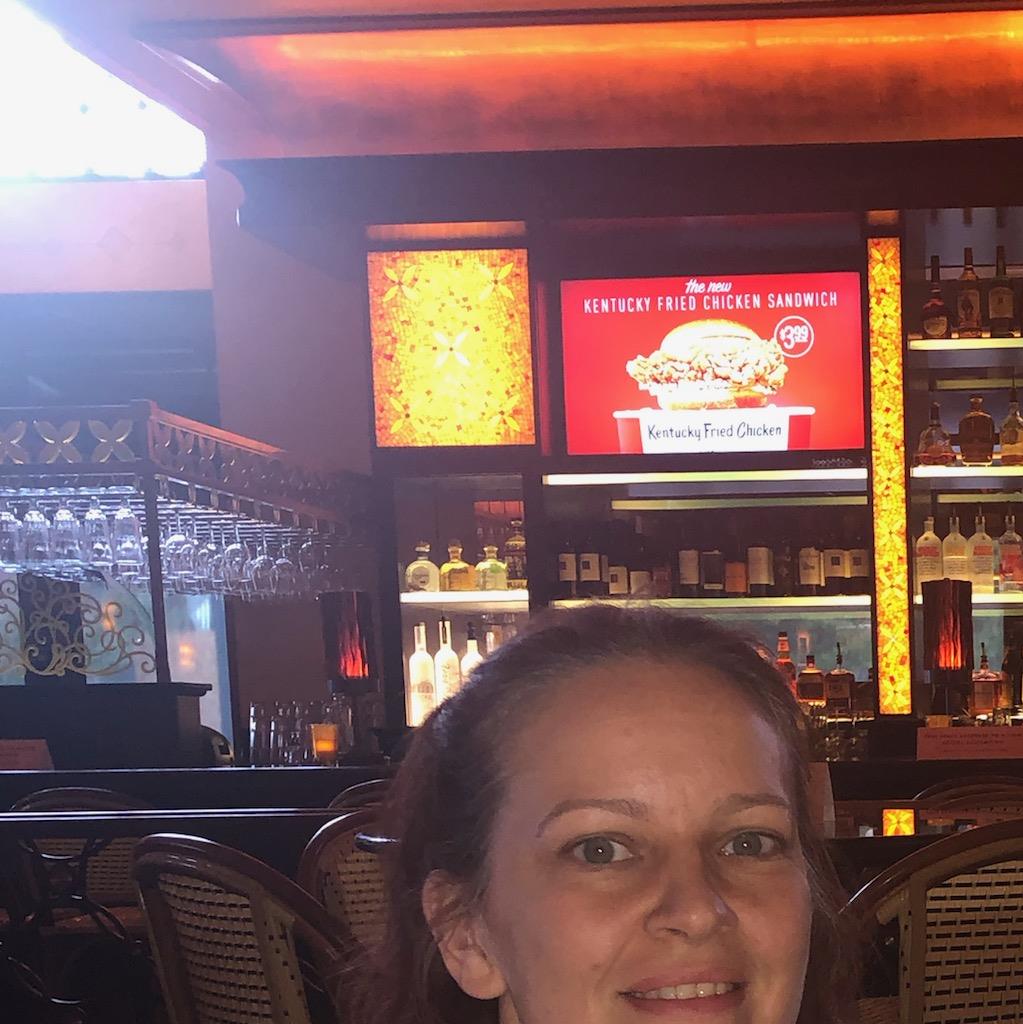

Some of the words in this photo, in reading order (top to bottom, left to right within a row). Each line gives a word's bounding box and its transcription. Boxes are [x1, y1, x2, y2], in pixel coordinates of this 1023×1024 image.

[685, 279, 706, 294] the
[707, 281, 732, 293] new
[584, 297, 651, 314] KENTUCKY
[657, 295, 697, 311] FRIED
[703, 294, 761, 310] CHICKEN
[767, 291, 838, 308] SANDWICH
[648, 424, 701, 441] Kentucky
[704, 423, 734, 439] Fried
[736, 421, 782, 438] Chicken
